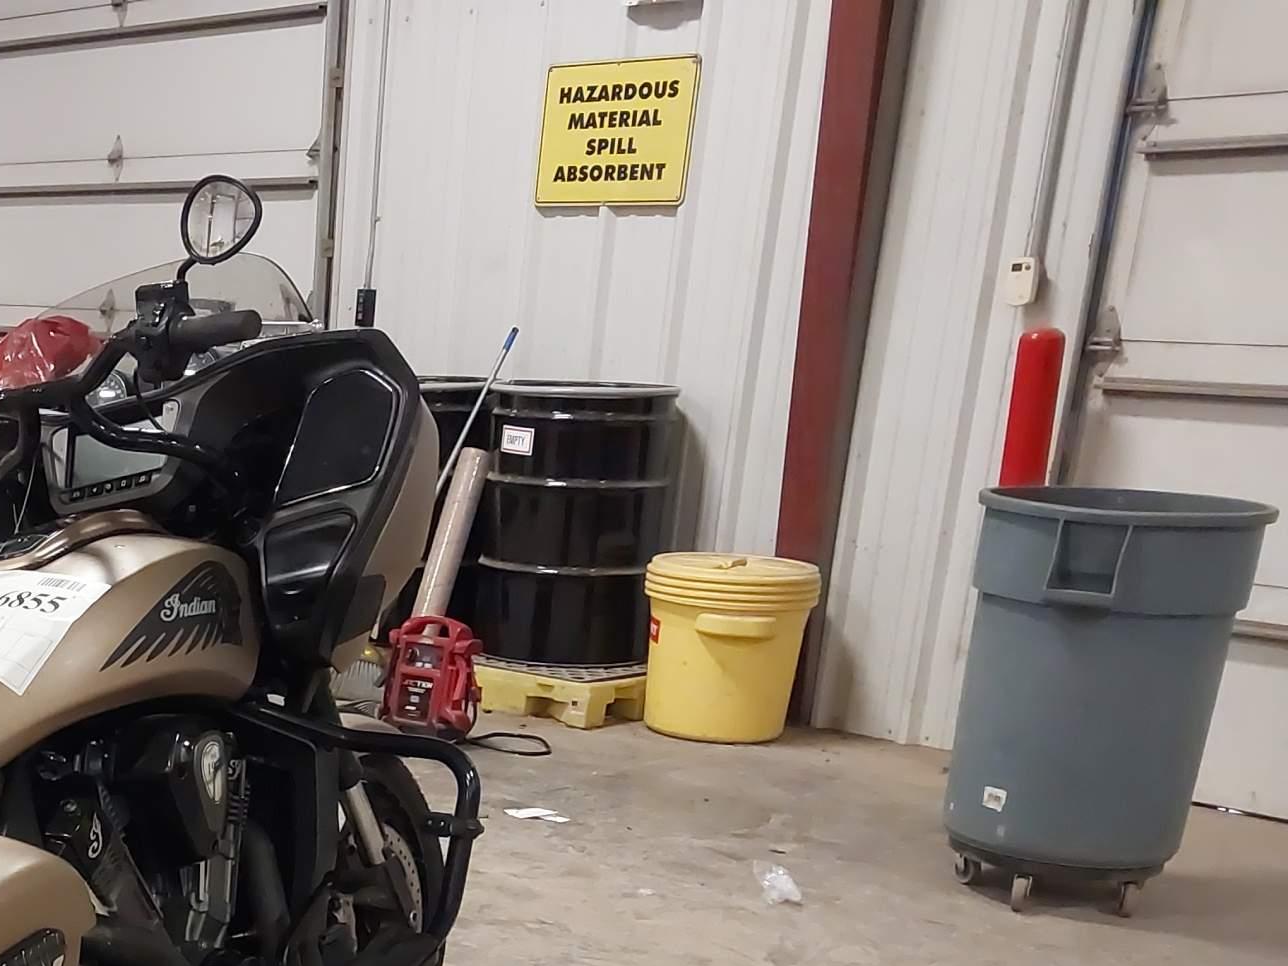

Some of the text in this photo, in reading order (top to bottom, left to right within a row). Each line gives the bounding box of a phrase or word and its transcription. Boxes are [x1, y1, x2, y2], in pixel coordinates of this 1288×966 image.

[559, 80, 680, 104] HAZARDOUS
[567, 108, 662, 130] MATERIAL
[585, 137, 637, 155] SPILL
[553, 163, 666, 182] ABSORBENT
[160, 593, 216, 621] Indian
